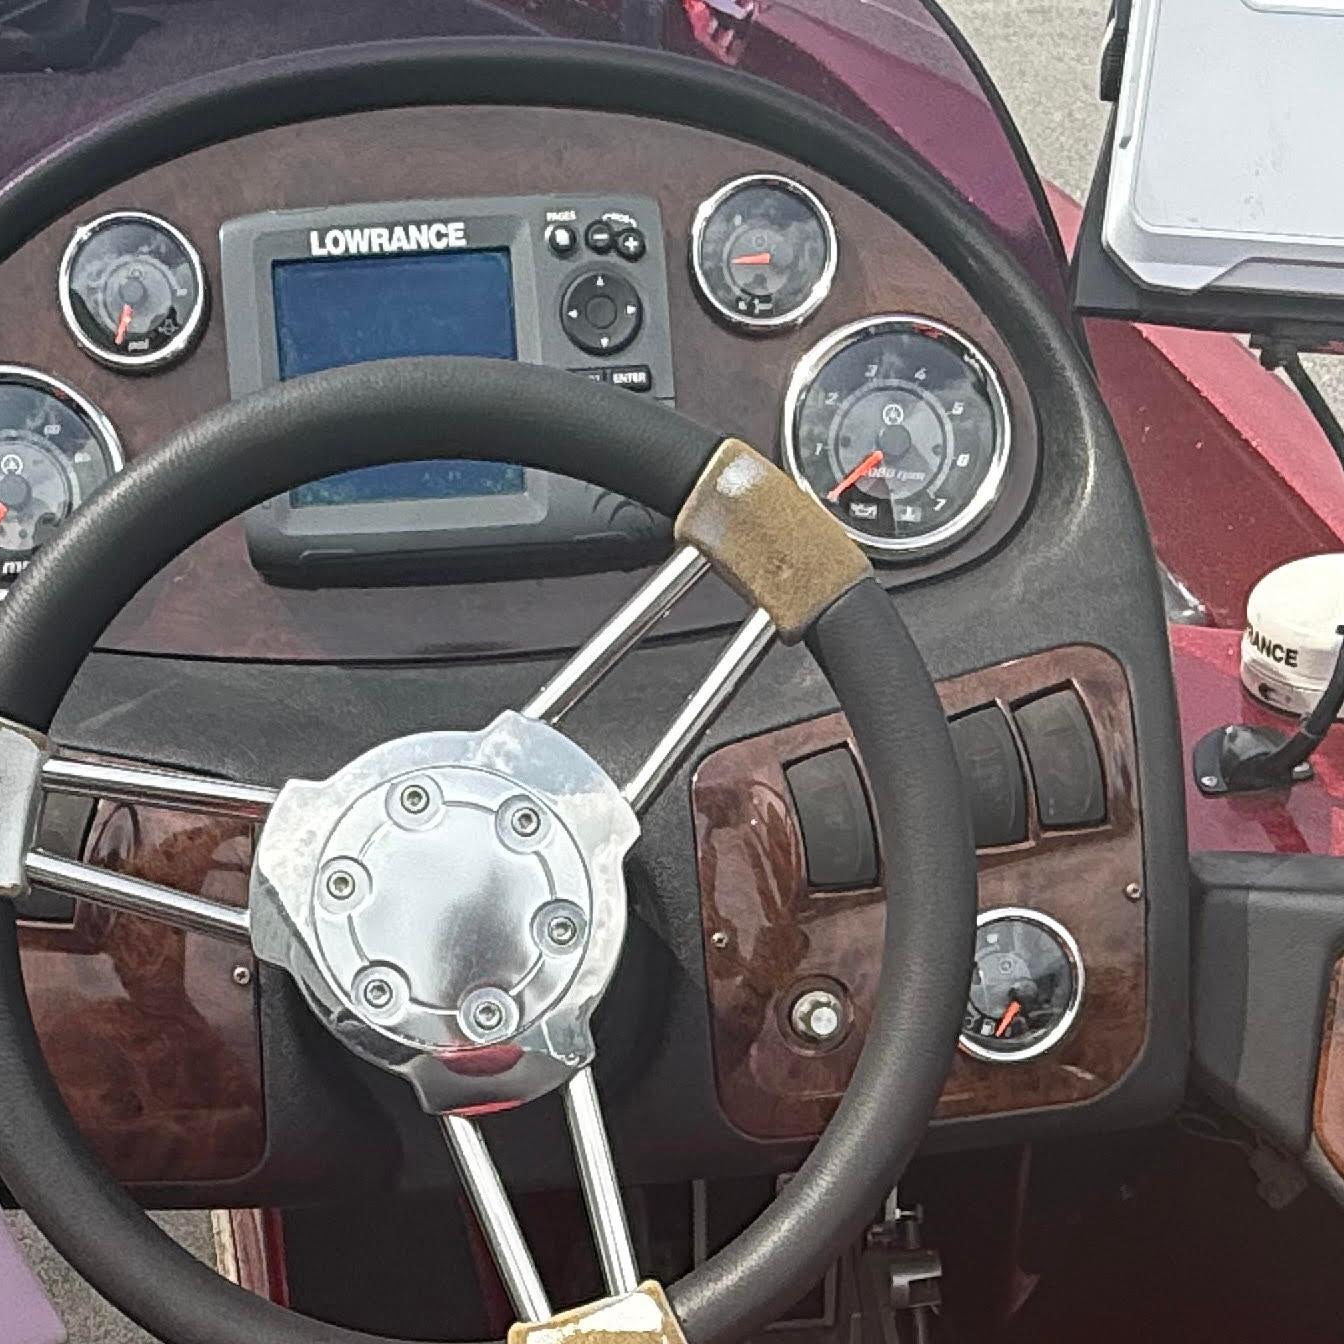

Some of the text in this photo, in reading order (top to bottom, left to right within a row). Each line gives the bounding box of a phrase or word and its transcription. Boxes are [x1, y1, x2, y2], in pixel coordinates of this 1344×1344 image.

[309, 222, 468, 256] LOWRANCE
[612, 371, 647, 385] ENTER
[864, 364, 879, 378] 3
[914, 367, 928, 381] 4
[824, 392, 839, 406] 2
[951, 401, 965, 415] 5
[815, 442, 824, 456] 1
[932, 498, 947, 512] 7
